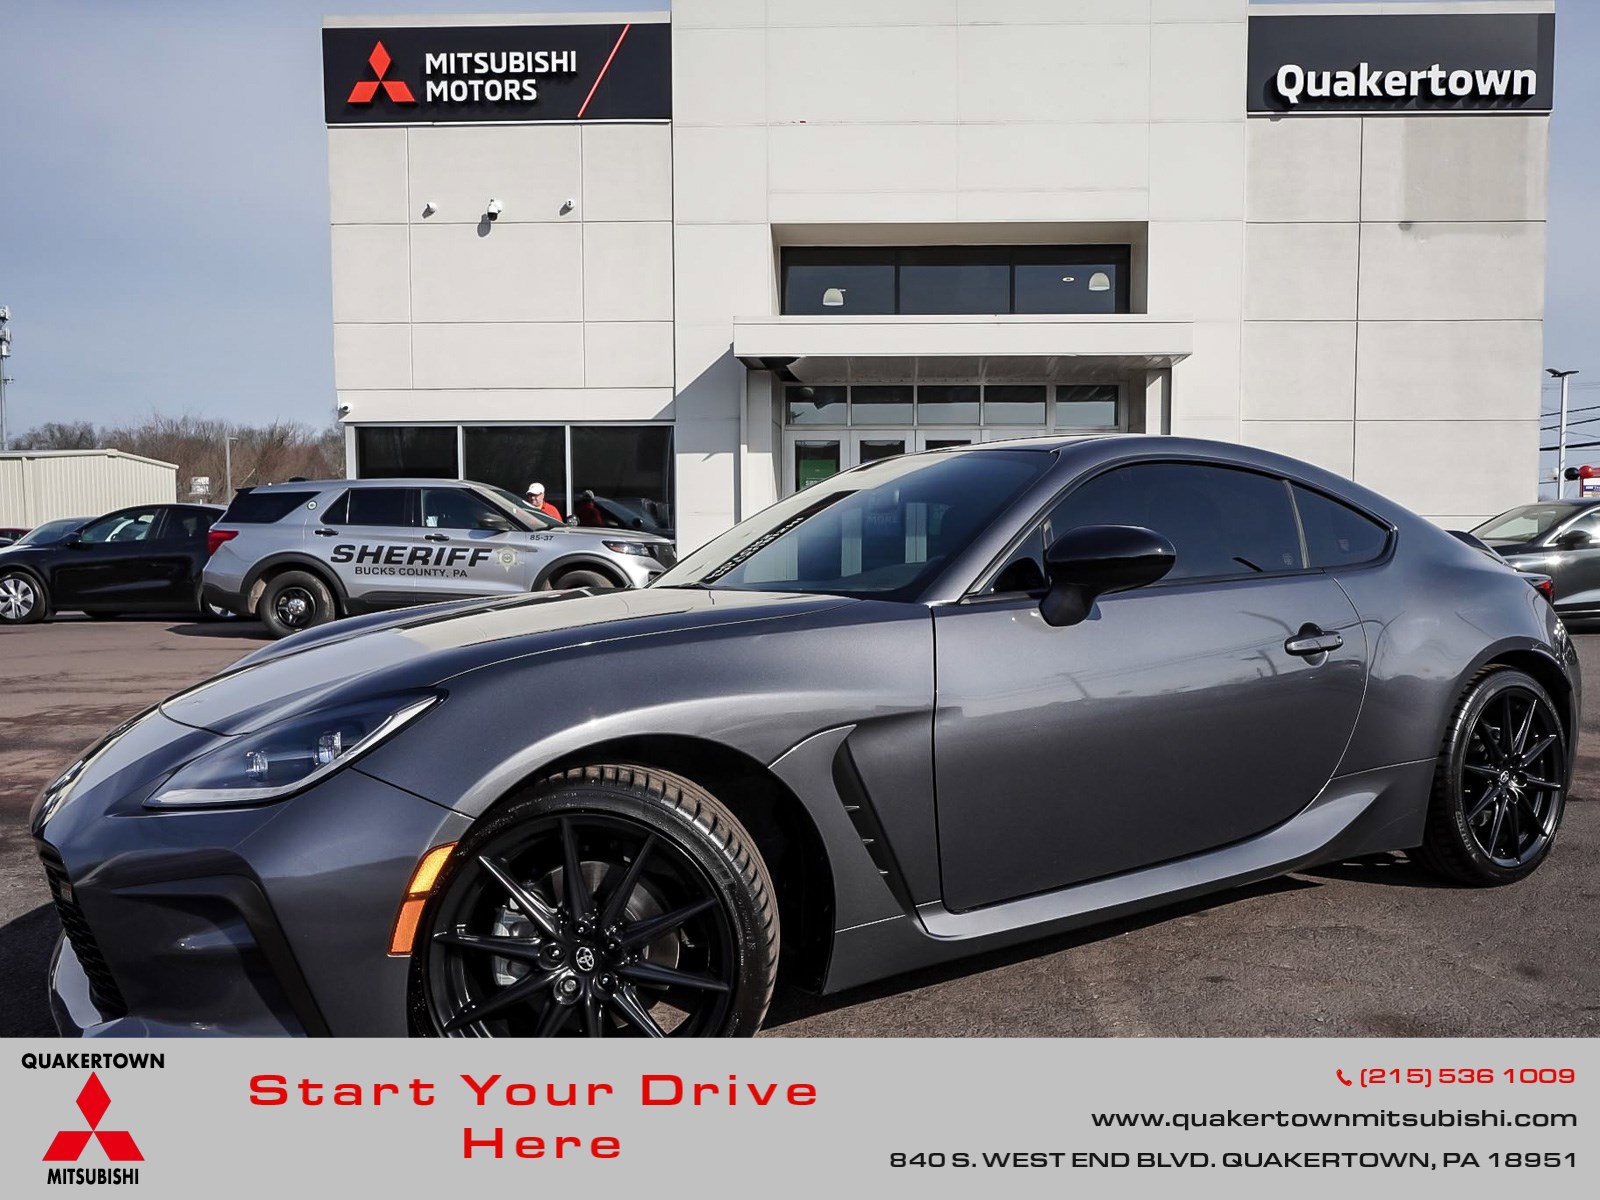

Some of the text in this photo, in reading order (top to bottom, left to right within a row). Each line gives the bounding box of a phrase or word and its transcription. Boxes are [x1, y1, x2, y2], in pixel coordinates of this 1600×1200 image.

[425, 50, 577, 75] MITSUBISHI
[425, 79, 537, 102] MOTORS
[1276, 62, 1537, 104] Quakertown
[529, 533, 555, 542] 85-37
[330, 544, 493, 567] SHERIFF
[354, 566, 468, 578] BUCKS COUNTY, PA
